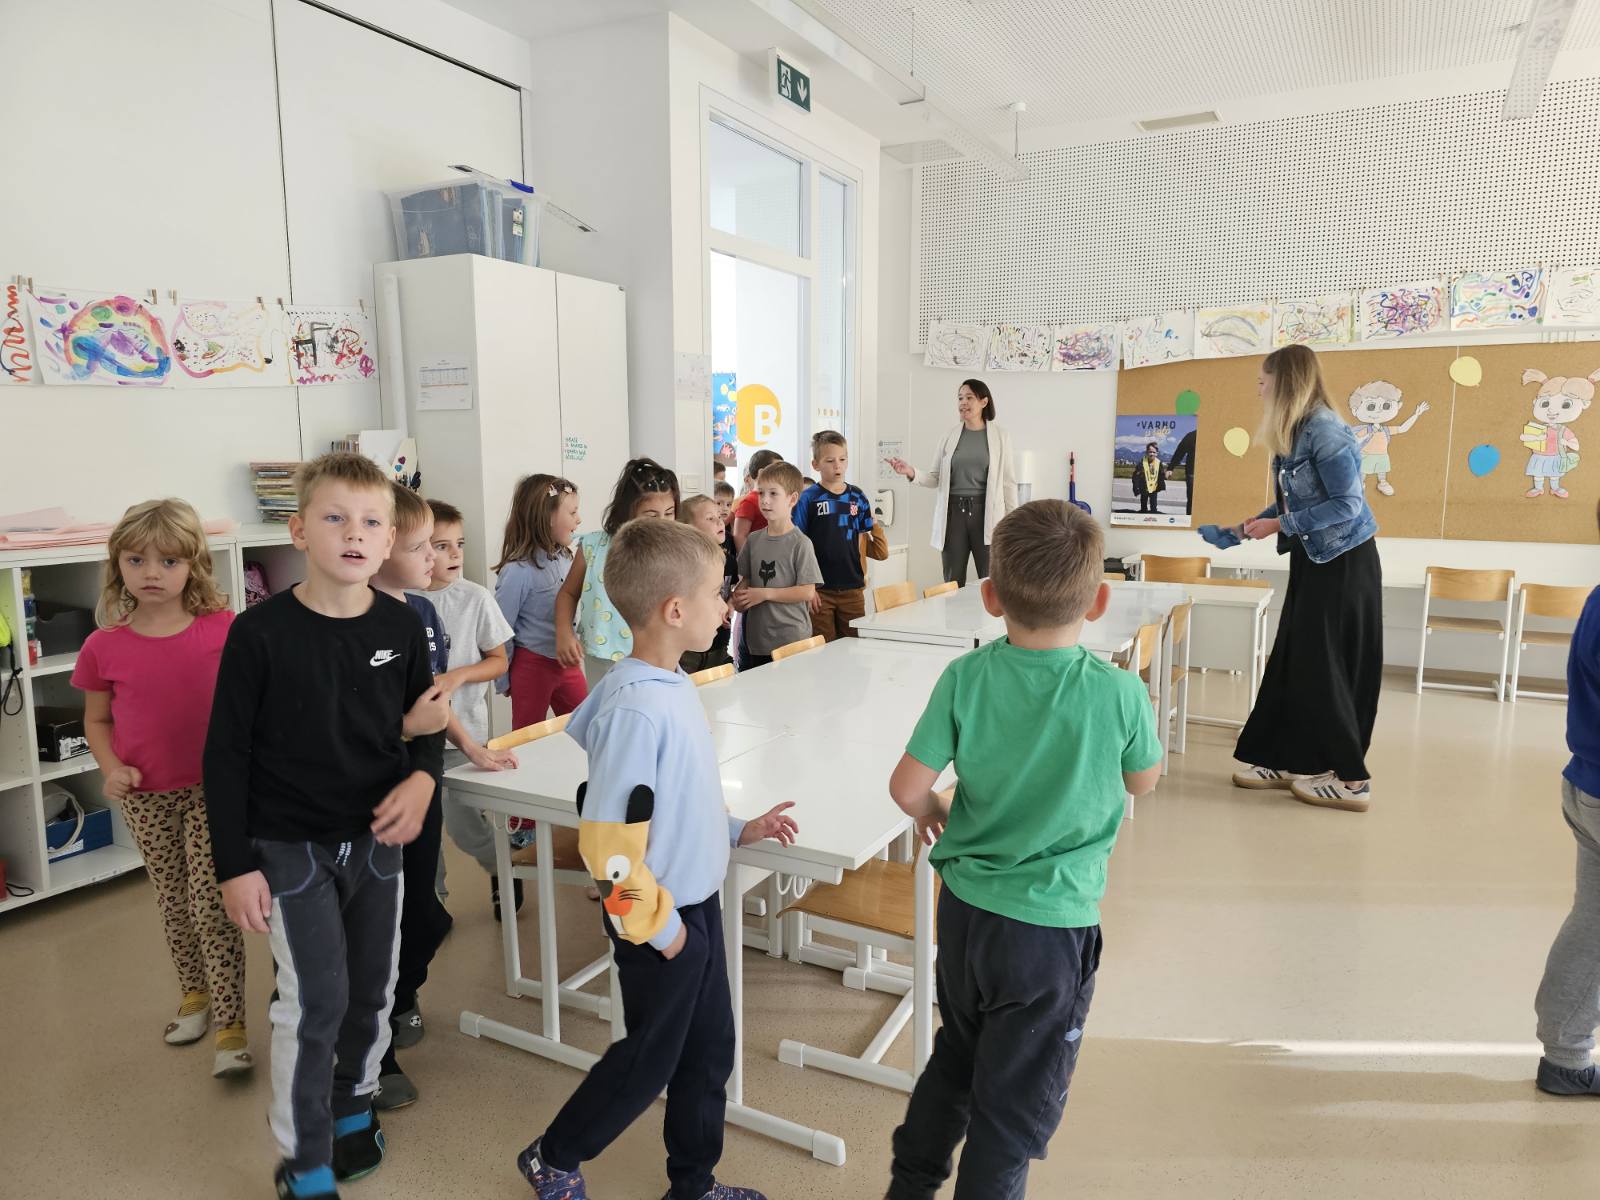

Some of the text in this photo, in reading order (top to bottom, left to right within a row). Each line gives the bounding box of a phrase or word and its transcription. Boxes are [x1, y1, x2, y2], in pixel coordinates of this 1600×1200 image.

[754, 404, 778, 442] B
[816, 501, 830, 516] 20
[374, 649, 394, 661] NIKE
